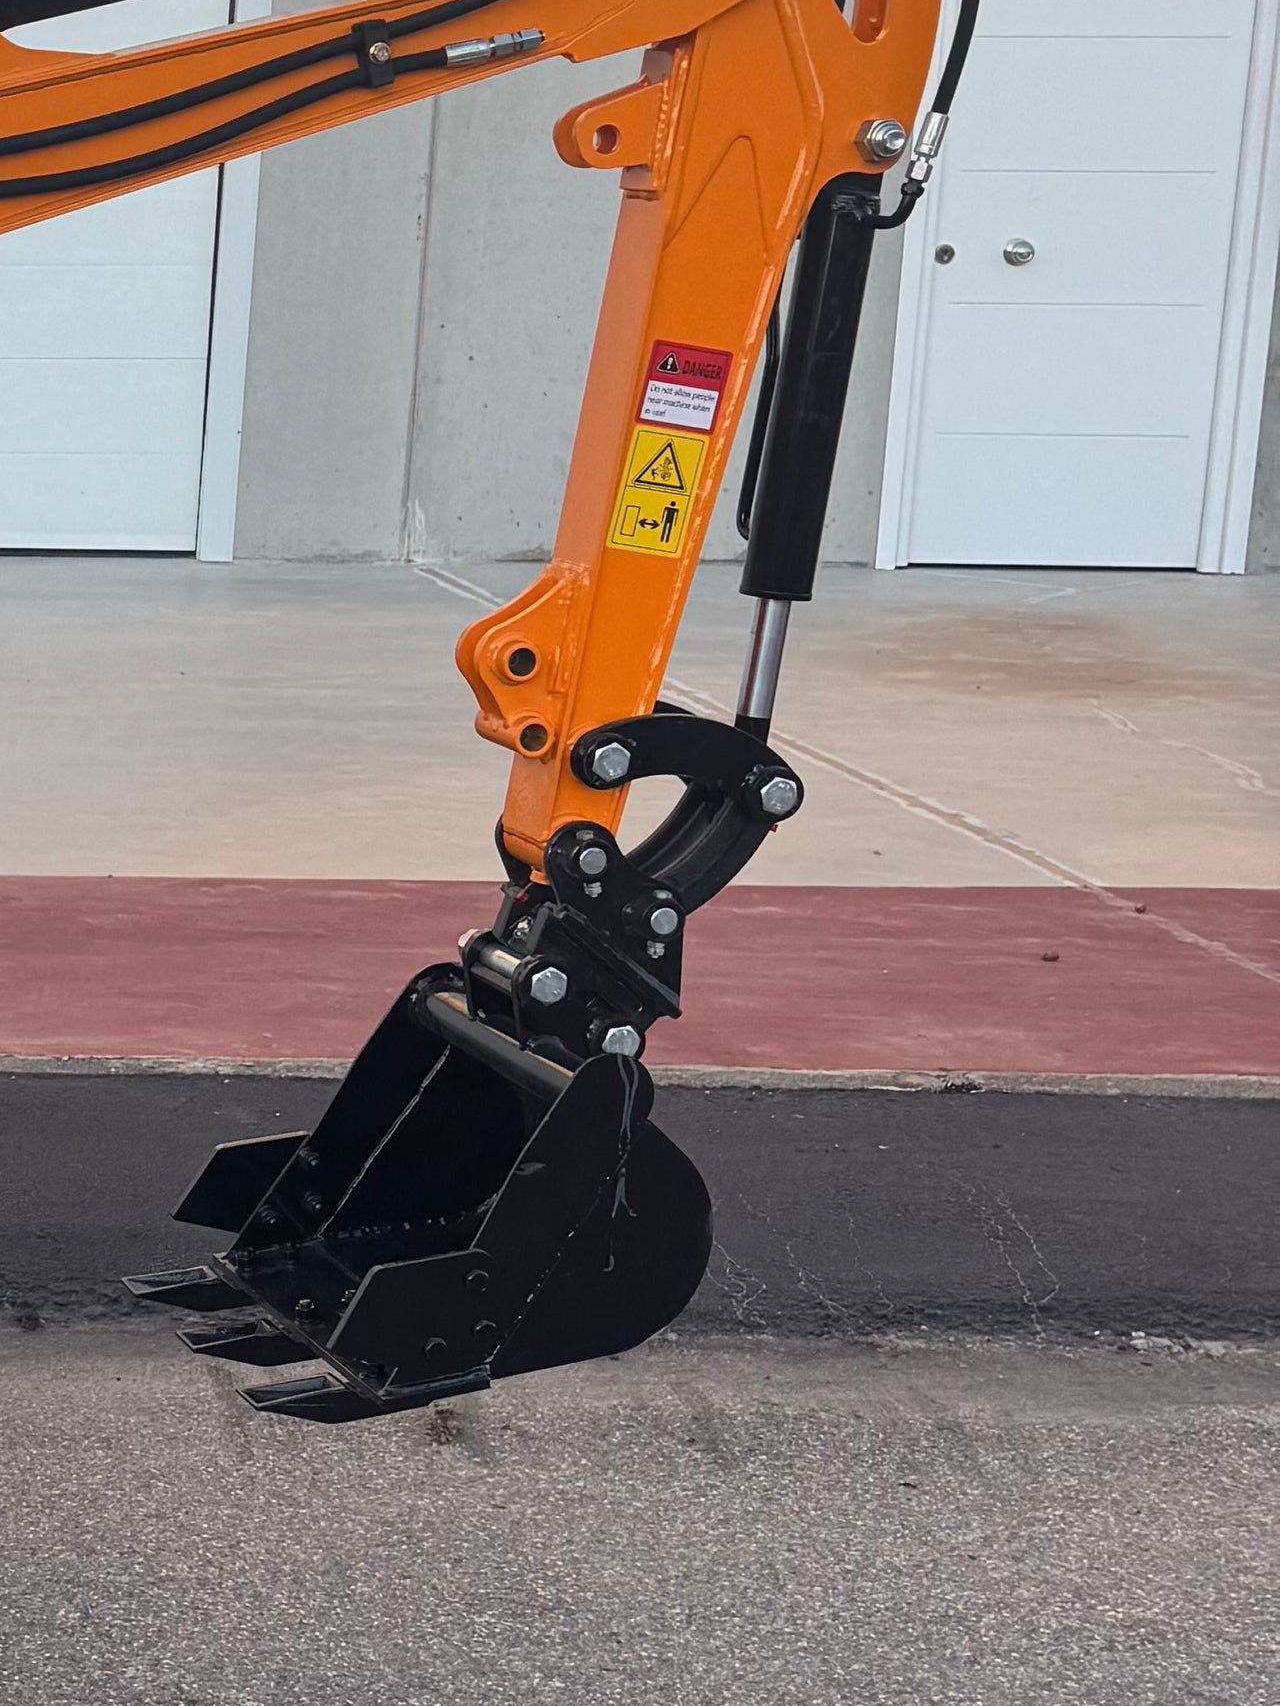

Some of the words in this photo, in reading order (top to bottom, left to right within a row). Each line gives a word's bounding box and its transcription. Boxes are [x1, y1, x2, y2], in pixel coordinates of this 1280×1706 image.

[682, 360, 723, 380] DANGER
[650, 384, 661, 393] Do
[661, 387, 673, 395] not
[692, 392, 716, 402] people
